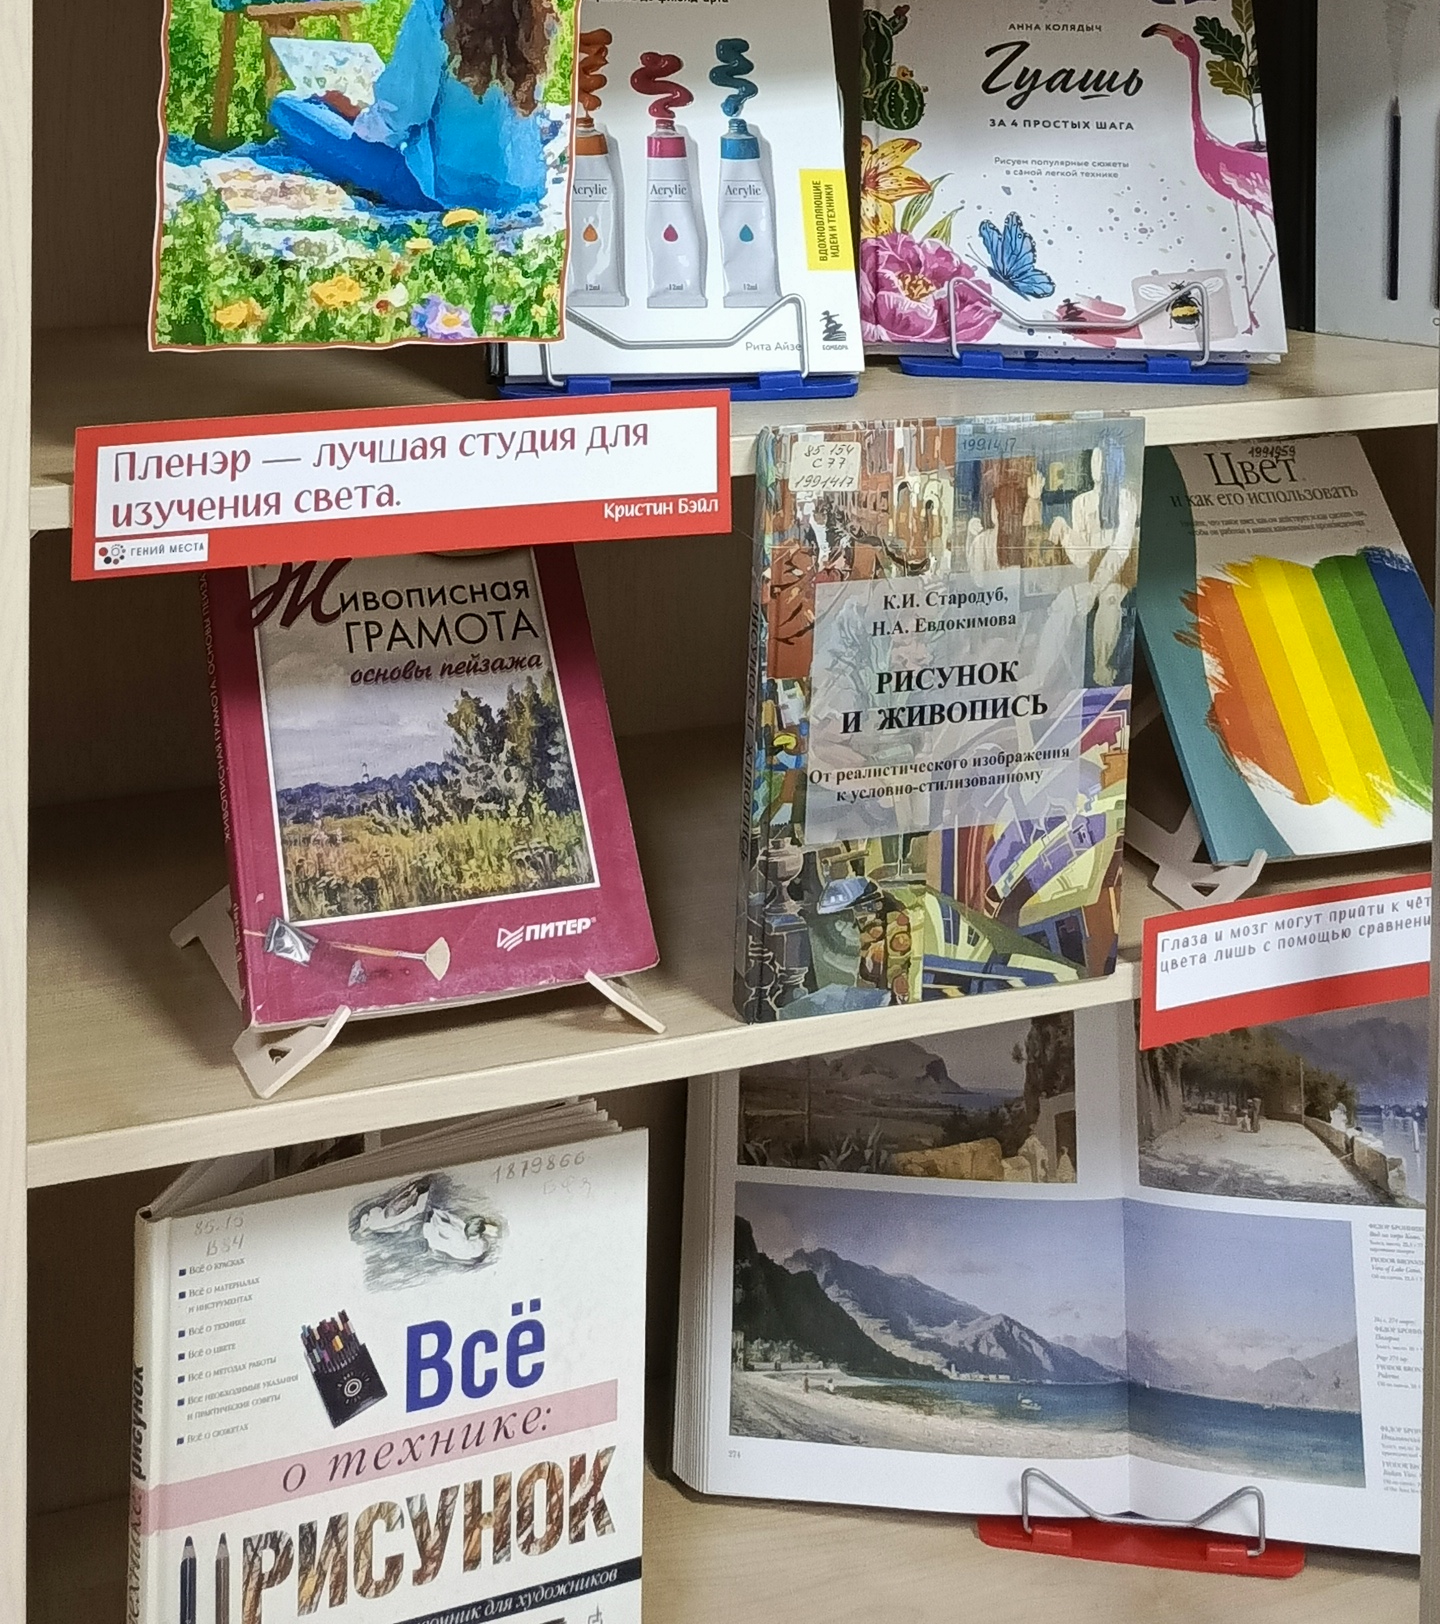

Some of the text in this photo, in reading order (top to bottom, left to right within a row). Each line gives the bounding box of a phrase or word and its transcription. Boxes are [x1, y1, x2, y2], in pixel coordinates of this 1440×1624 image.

[1008, 22, 1102, 32] АННА КОЛЯДЫЧ
[981, 40, 1144, 110] Гуашь
[989, 119, 1134, 131] ЗА 4 ПРОСТЫХ ШАГА
[994, 156, 1129, 169] Рисуем популярные сюжеты
[1013, 168, 1042, 177] самой
[1080, 171, 1119, 179] технике
[650, 184, 687, 198] Acrylic
[725, 184, 762, 198] Acrylic
[824, 184, 836, 223] ТЕХНИКИ
[812, 180, 828, 261] ВДОХНОВЛЯЮЩИЕ
[829, 234, 840, 258] ИДЕИ
[746, 342, 772, 351] Рита
[114, 423, 648, 483] Пленэр лучшая студия для
[1204, 452, 1297, 490] Цвет
[112, 483, 401, 529] изучения света.
[604, 498, 719, 522] Кристин Бэйл
[1186, 494, 1215, 507] как
[1217, 493, 1244, 506] его
[1249, 486, 1358, 505] использовать
[130, 542, 204, 557] ГЕНИЙ МЕСТА
[883, 587, 1008, 610] К.И. Стародуб,
[345, 609, 540, 654] ГРАМОТА
[872, 612, 1016, 637] Н.А. Евдокимова
[350, 653, 543, 686] основы пейзажа
[876, 660, 1020, 694] РИСУНОК
[841, 694, 1048, 734] И ЖИВОПИСЬ
[808, 746, 1070, 784] От реалистического изображения
[836, 769, 1043, 801] к условно-стилизованному
[525, 917, 592, 943] ПИТЕР
[1161, 934, 1207, 953] Глаза
[1214, 930, 1223, 941] и
[1230, 923, 1268, 939] мозг
[1275, 913, 1323, 931] могут
[1329, 903, 1384, 923] прийти
[1391, 901, 1399, 913] к
[1160, 952, 1207, 973] цвета
[1214, 943, 1256, 962] лишь
[1263, 941, 1270, 951] с
[1277, 930, 1351, 950] помощью
[406, 1298, 546, 1413] Всё
[283, 1406, 552, 1492] о технике:
[242, 1445, 616, 1624] РИСУНОК
[484, 1567, 618, 1616] для художников
